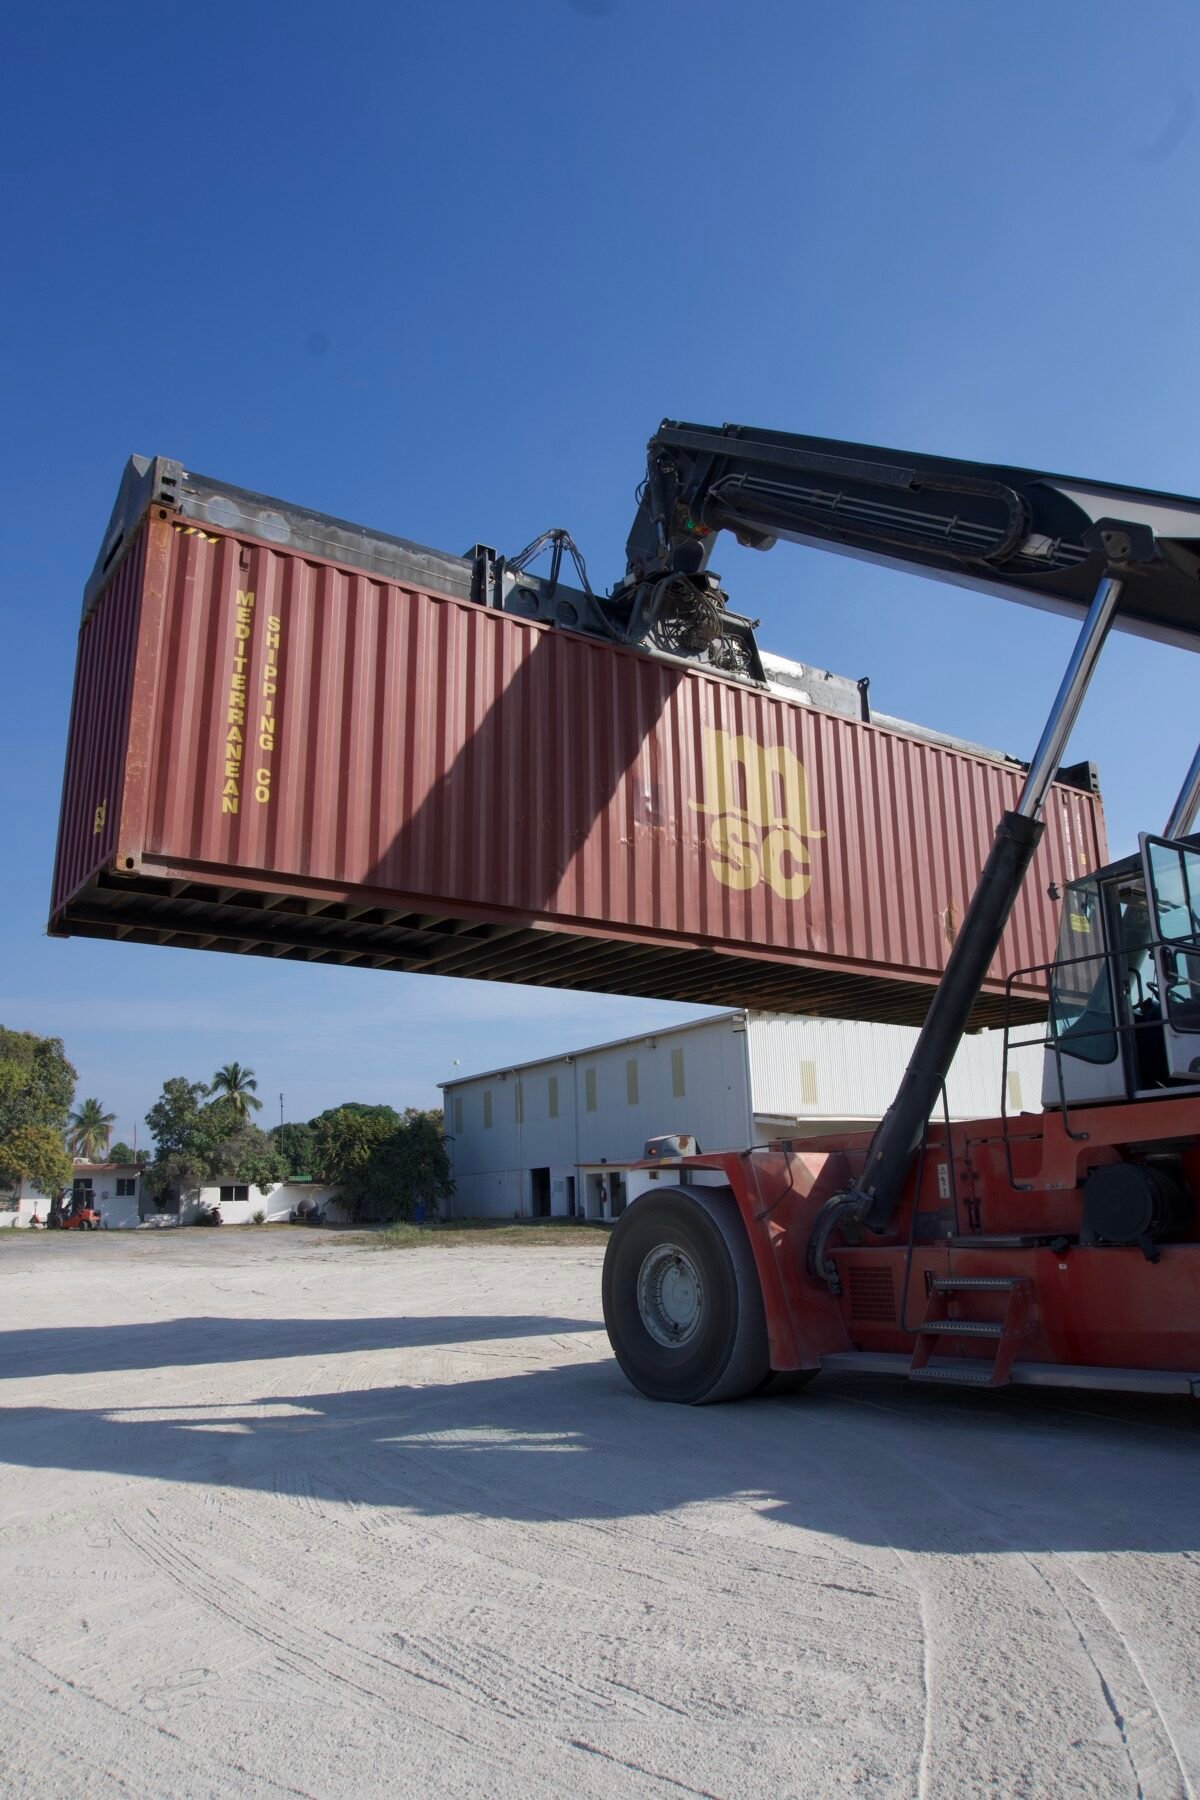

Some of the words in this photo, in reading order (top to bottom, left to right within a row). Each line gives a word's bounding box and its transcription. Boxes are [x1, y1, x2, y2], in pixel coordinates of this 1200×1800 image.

[222, 589, 255, 813] MEDITERRANEAN
[259, 615, 281, 751] SHIPPING
[255, 768, 271, 803] CO
